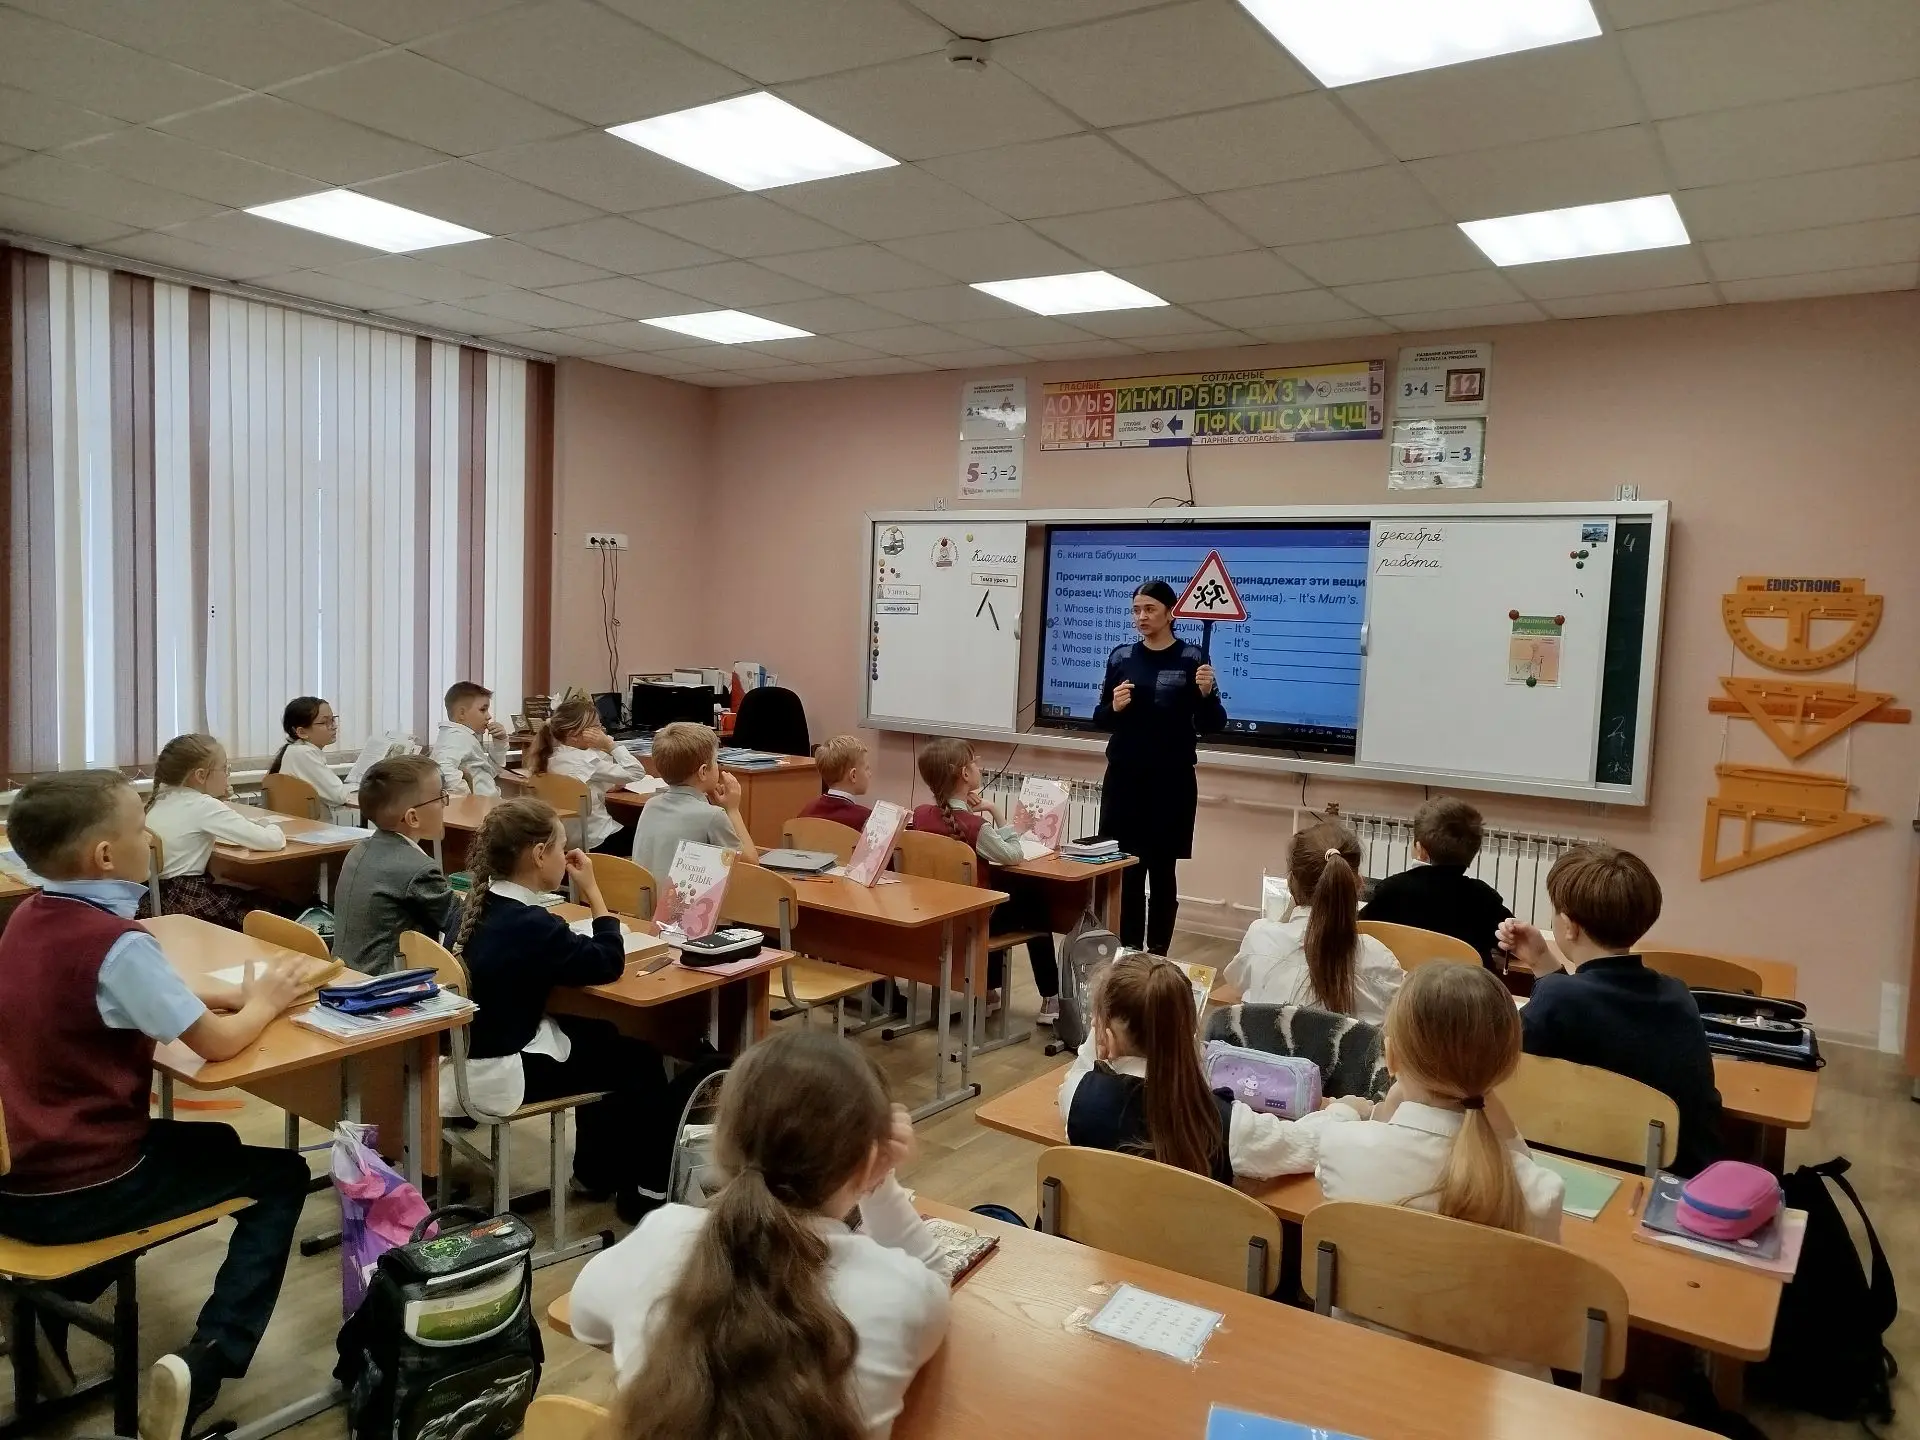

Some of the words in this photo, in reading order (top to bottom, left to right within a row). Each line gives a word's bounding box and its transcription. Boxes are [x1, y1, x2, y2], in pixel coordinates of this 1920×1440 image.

[1201, 371, 1265, 382] СОГЛАСНЫЕ
[1059, 382, 1101, 391] ГЛАСНЫЕ
[1452, 374, 1477, 395] 12
[1200, 436, 1234, 444] ПАРНЫЕ
[971, 549, 1018, 564] Классная
[1057, 550, 1065, 559] 6.
[1067, 551, 1093, 559] книга
[1095, 550, 1137, 561] бабушки
[1056, 572, 1103, 583] Прочитай
[1104, 574, 1141, 583] вопрос
[1143, 575, 1150, 583] и
[1308, 577, 1330, 586] эти
[1055, 588, 1101, 598] Образец:
[1103, 589, 1133, 598] Whose
[1299, 592, 1316, 603] It's
[1318, 593, 1359, 605] Mum's.
[1064, 605, 1094, 614] Whose
[1096, 605, 1104, 614] is
[1105, 606, 1122, 615] this
[1063, 617, 1093, 626] Whose
[1095, 619, 1103, 627] is
[1104, 619, 1121, 628] this
[1234, 623, 1251, 633] It's
[1052, 630, 1059, 638] 3.
[1062, 631, 1092, 640] Whose
[1094, 632, 1102, 640] is
[1103, 632, 1120, 641] this
[1233, 638, 1250, 648] It's
[1062, 643, 1091, 653] Whose
[1094, 645, 1102, 654] is
[1233, 652, 1249, 662] It's
[1051, 657, 1059, 666] 5.
[1061, 657, 1091, 667] Whose
[1093, 658, 1100, 667] is
[1232, 666, 1248, 677] It's
[1050, 679, 1090, 689] Напиши
[675, 858, 706, 873] Русский
[686, 897, 714, 937] 3
